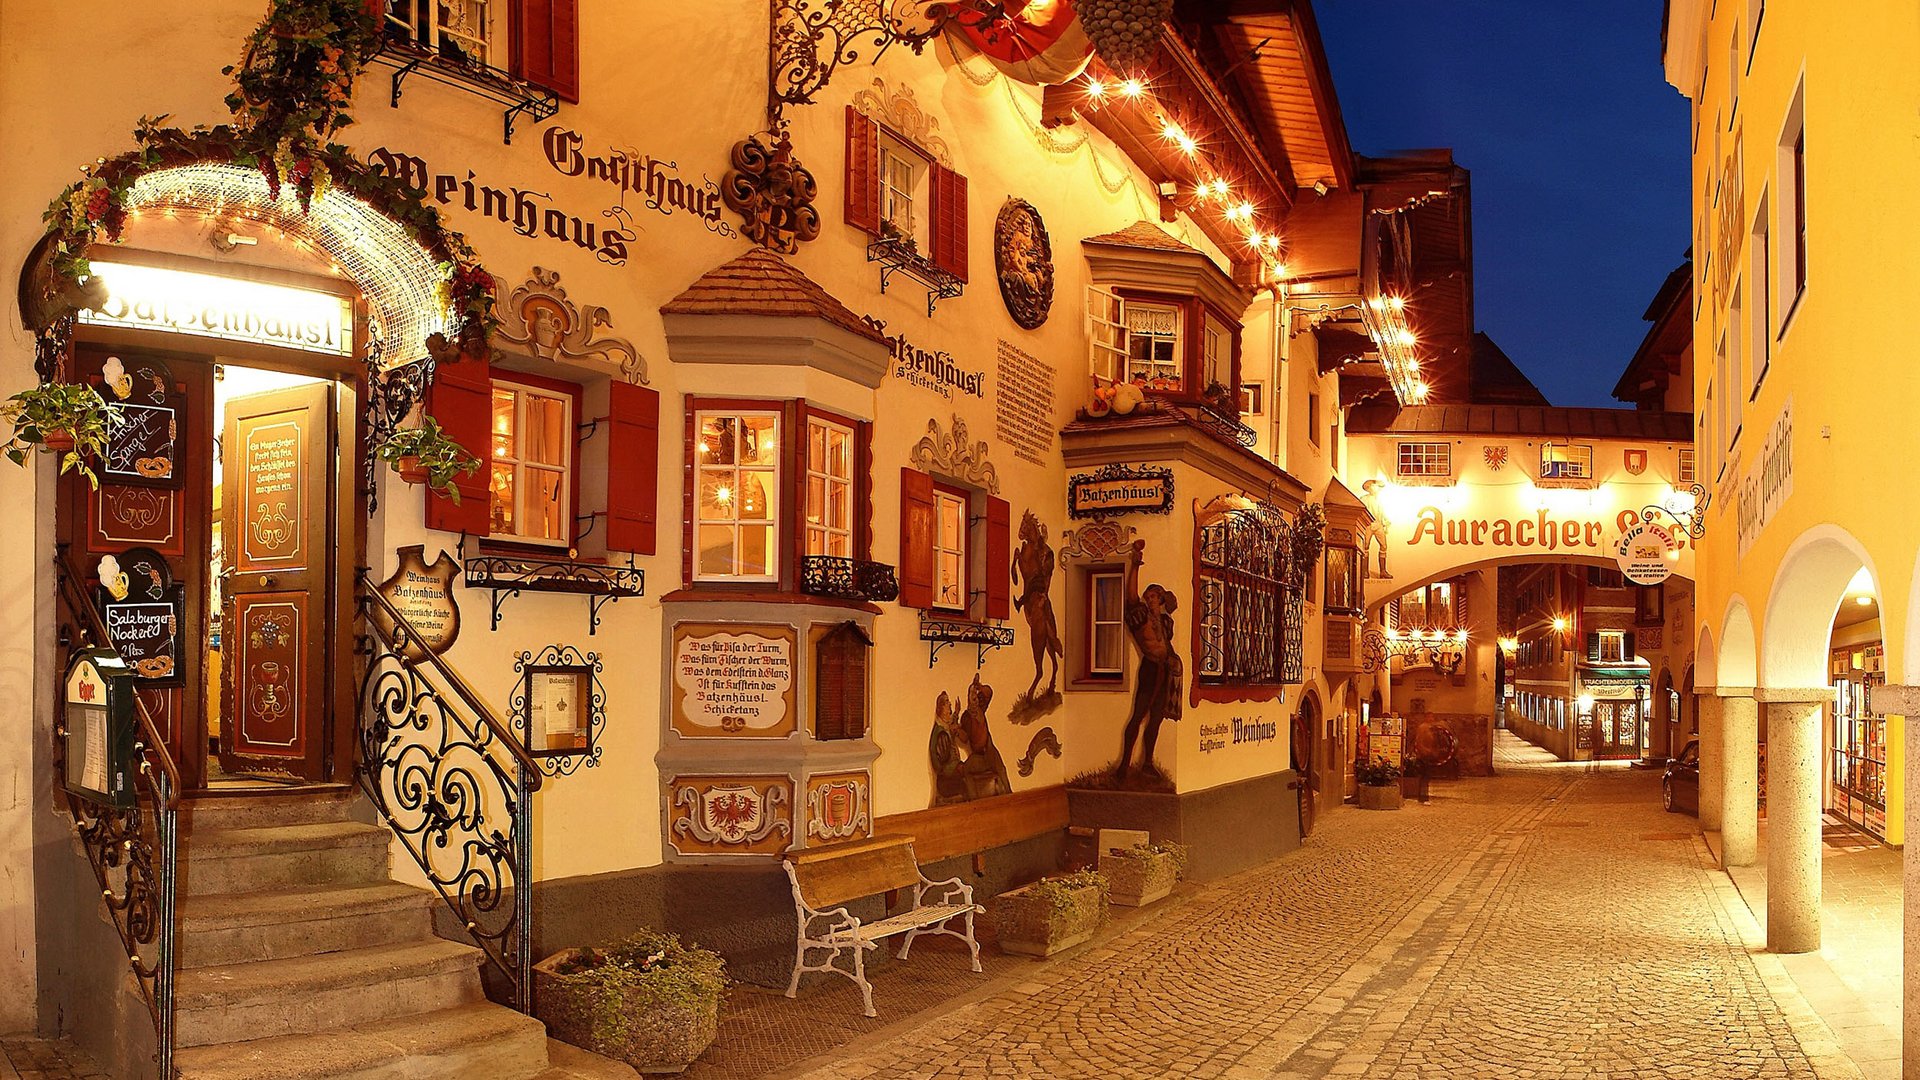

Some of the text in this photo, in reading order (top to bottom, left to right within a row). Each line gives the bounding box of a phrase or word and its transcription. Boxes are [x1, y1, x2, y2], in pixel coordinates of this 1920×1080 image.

[542, 125, 737, 241] Gasthaus
[367, 146, 637, 267] Weinhaus
[1079, 483, 1162, 504] Batzenhäusl
[1406, 504, 1604, 552] Auracher
[1619, 525, 1675, 557] Bella Itali
[109, 609, 171, 636] Salzburger
[680, 654, 701, 664] Was
[748, 655, 761, 665] der
[688, 641, 711, 651] Was
[742, 642, 756, 652] der
[682, 667, 705, 676] Was
[705, 667, 722, 676] dem
[711, 678, 725, 690] für
[760, 680, 777, 690] das
[1230, 715, 1277, 747] Weinhaus
